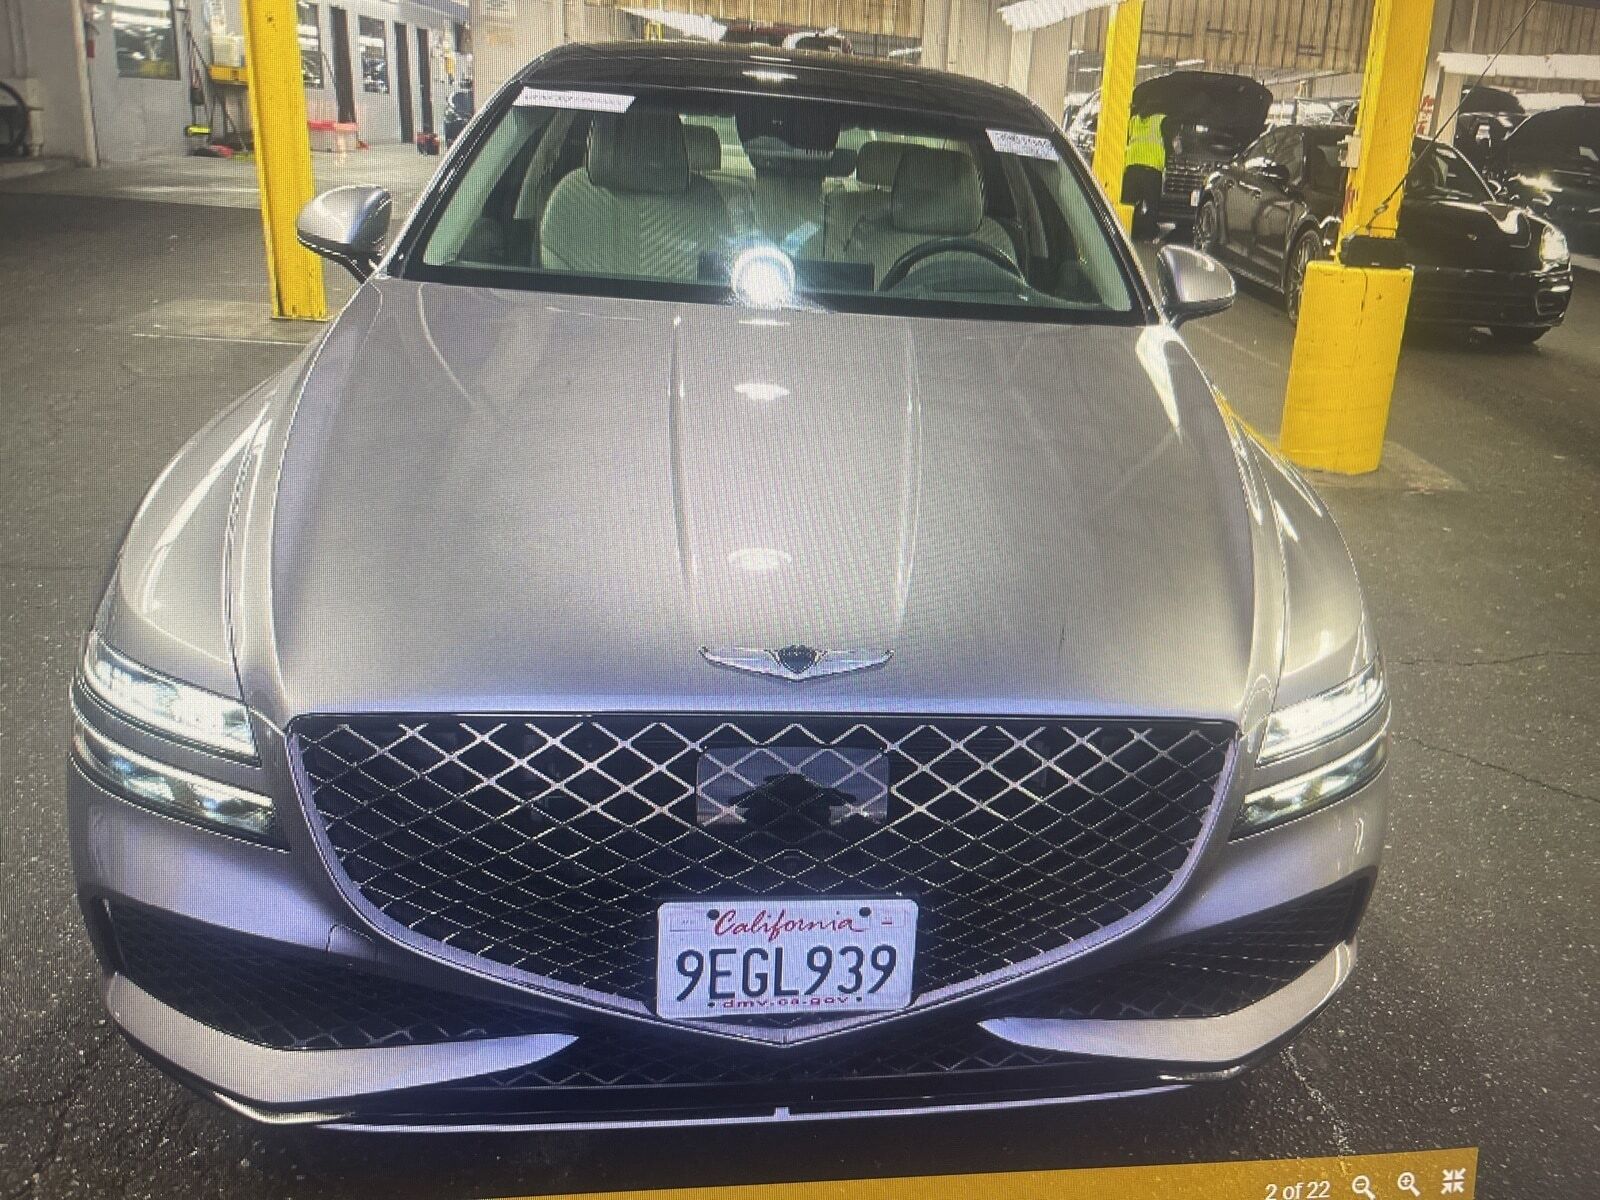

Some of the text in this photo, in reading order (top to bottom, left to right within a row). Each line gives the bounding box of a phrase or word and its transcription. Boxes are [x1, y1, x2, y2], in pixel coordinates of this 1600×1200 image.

[714, 909, 864, 941] California
[676, 944, 897, 1001] 9EGL939
[723, 995, 849, 1008] dmv.ca.gov
[1265, 1180, 1331, 1200] 2 of 22
